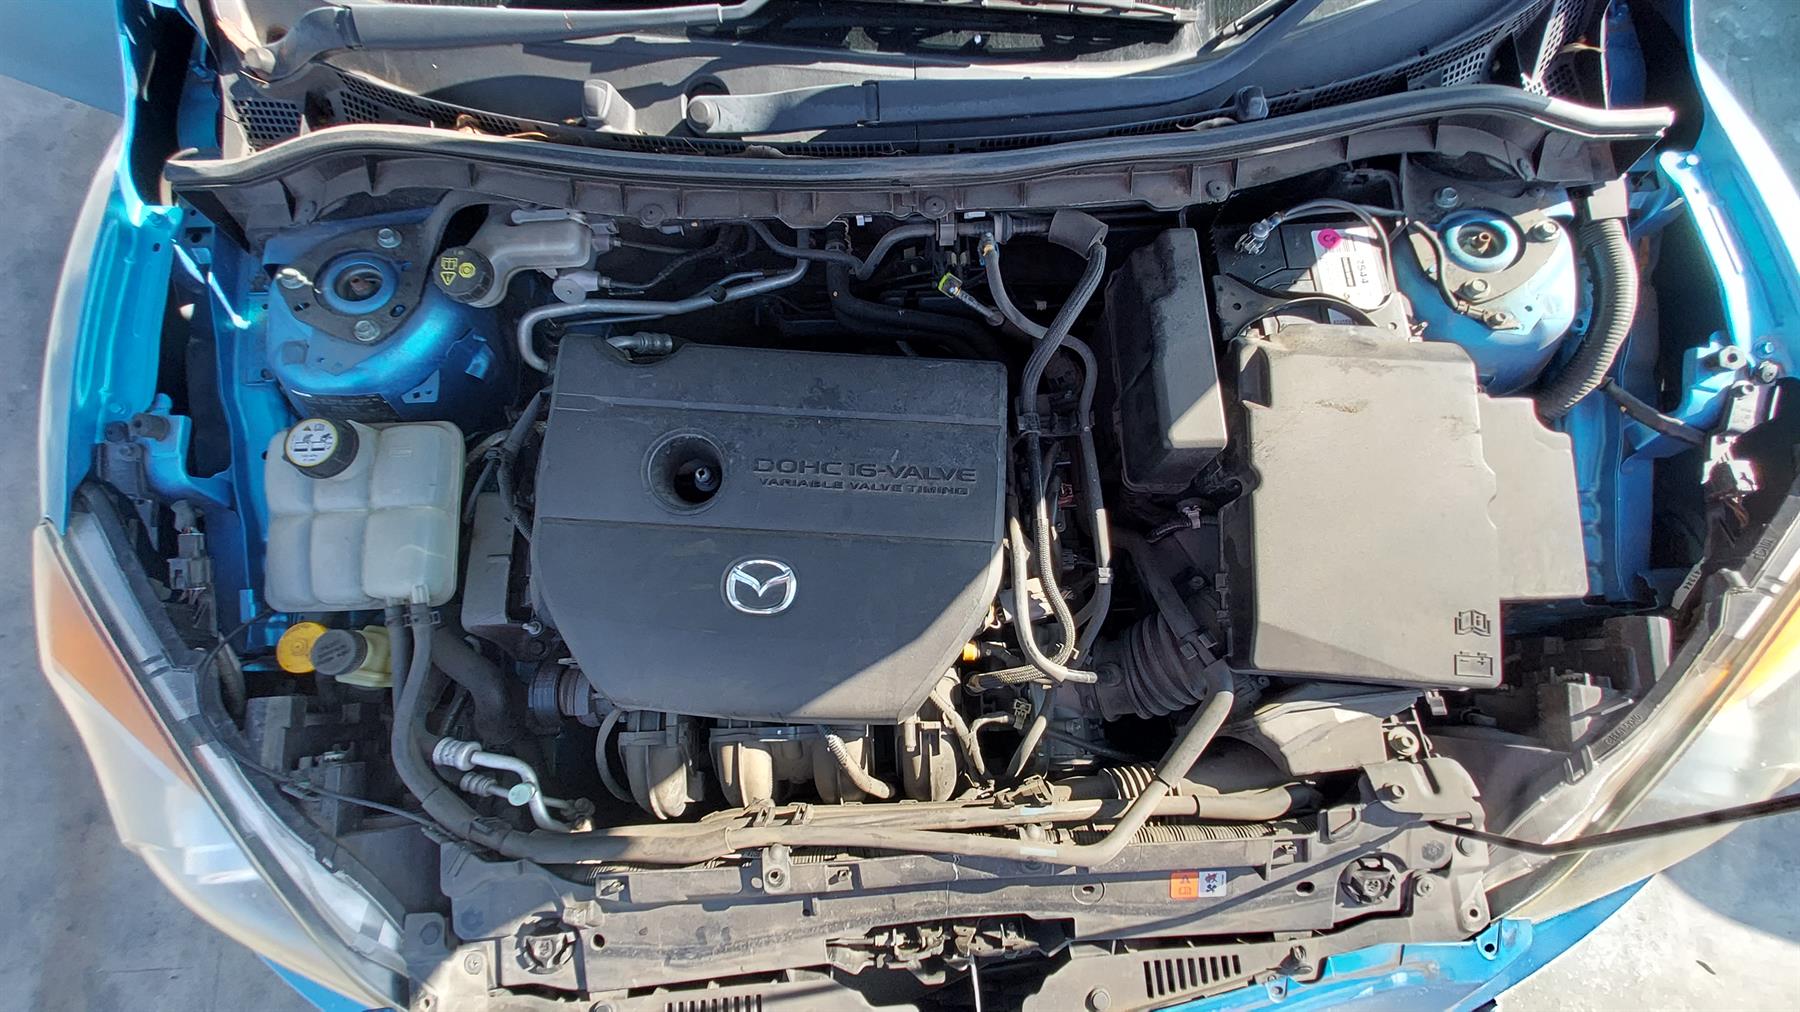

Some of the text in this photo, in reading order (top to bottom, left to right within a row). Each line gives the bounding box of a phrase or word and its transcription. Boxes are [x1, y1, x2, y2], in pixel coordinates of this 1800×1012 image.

[754, 459, 977, 483] DOHC 16-VALVE
[760, 478, 970, 497] VARIABLE VALVE TIMING
